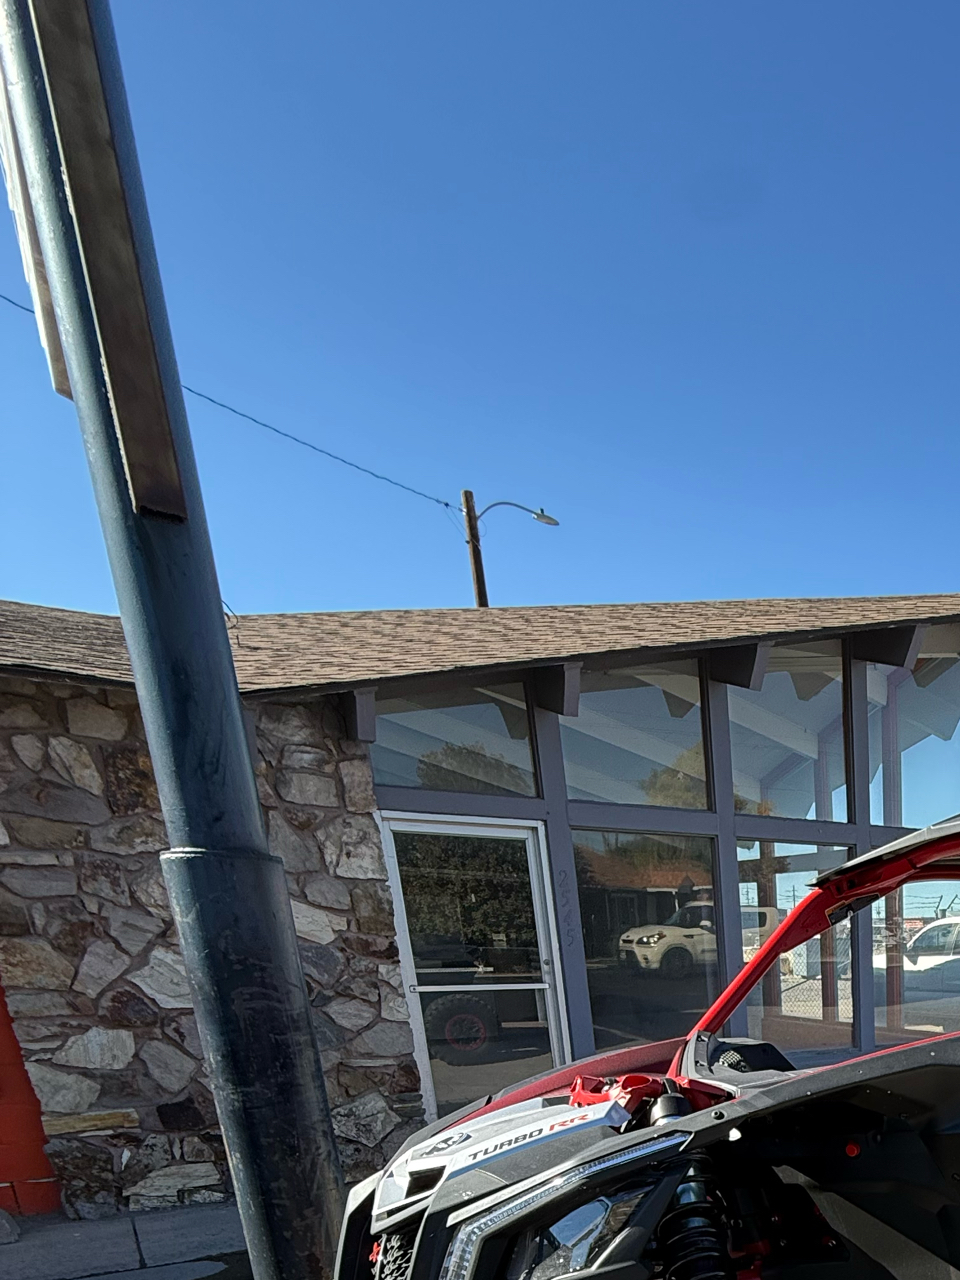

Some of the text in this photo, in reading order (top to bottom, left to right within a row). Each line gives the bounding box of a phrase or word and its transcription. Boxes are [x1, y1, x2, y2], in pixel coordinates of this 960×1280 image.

[559, 870, 576, 947] 2545
[468, 1114, 589, 1161] TURBO RR
